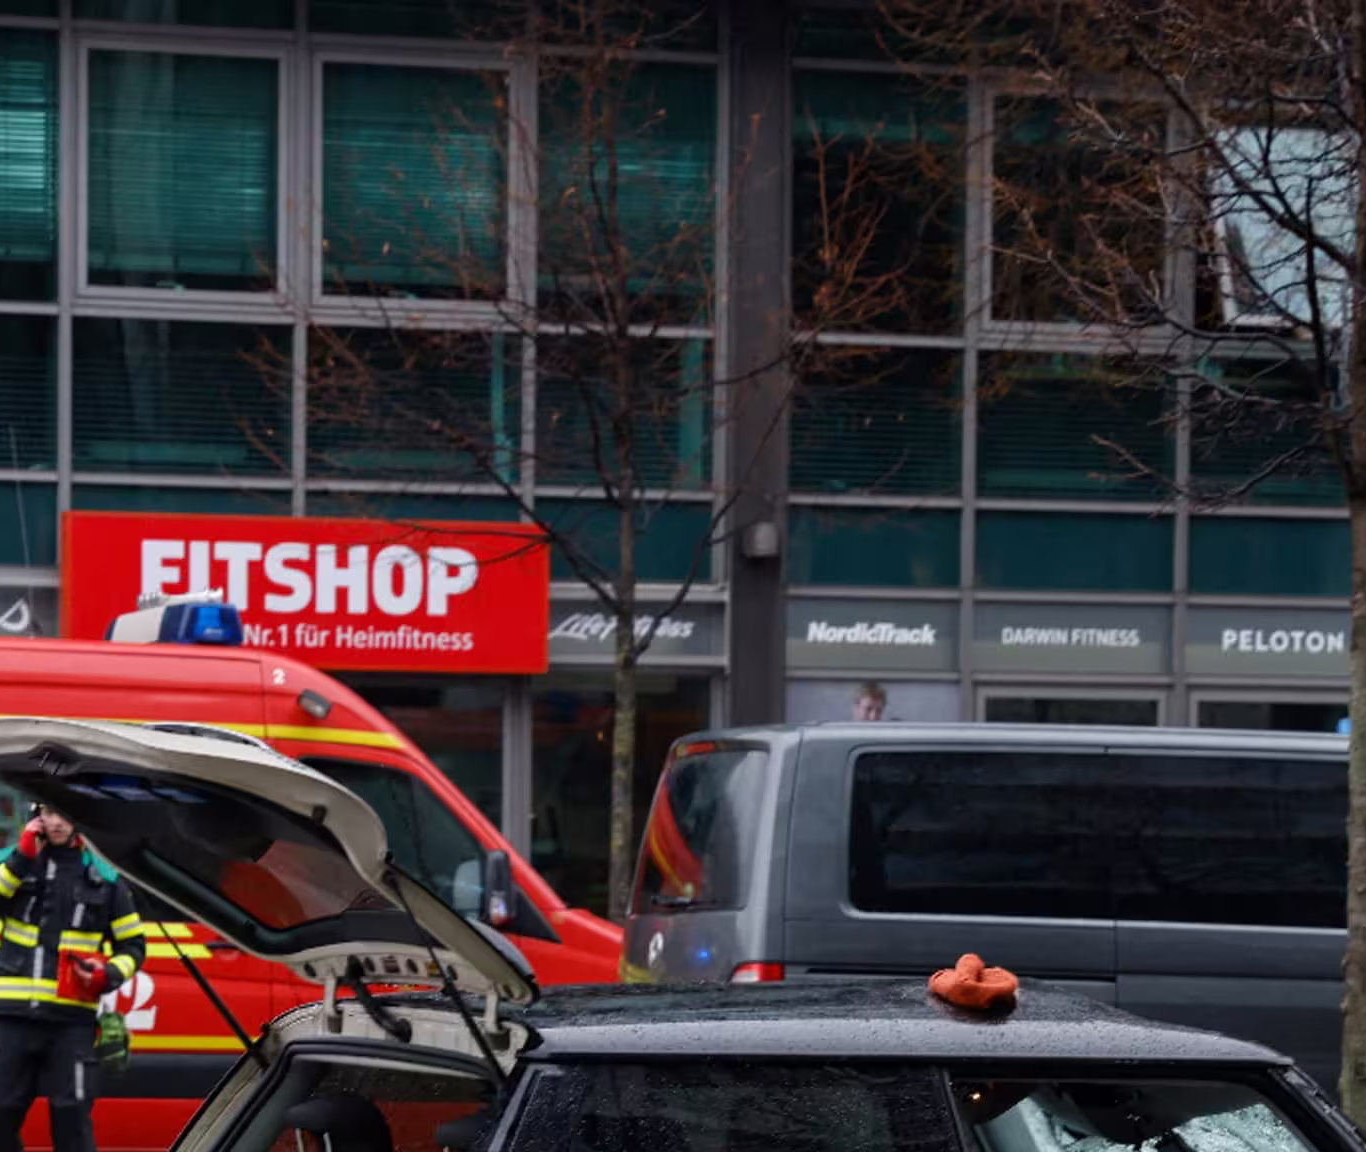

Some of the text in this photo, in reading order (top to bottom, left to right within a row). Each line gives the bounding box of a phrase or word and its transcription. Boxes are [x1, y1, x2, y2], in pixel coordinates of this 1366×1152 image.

[140, 539, 480, 616] FITSHOP
[295, 623, 330, 646] für
[336, 625, 474, 651] Heimfitness
[807, 621, 937, 646] NordicTrack
[1001, 626, 1141, 648] DARWIN FITNESS
[1222, 628, 1346, 652] PELOTON
[272, 667, 286, 685] 2
